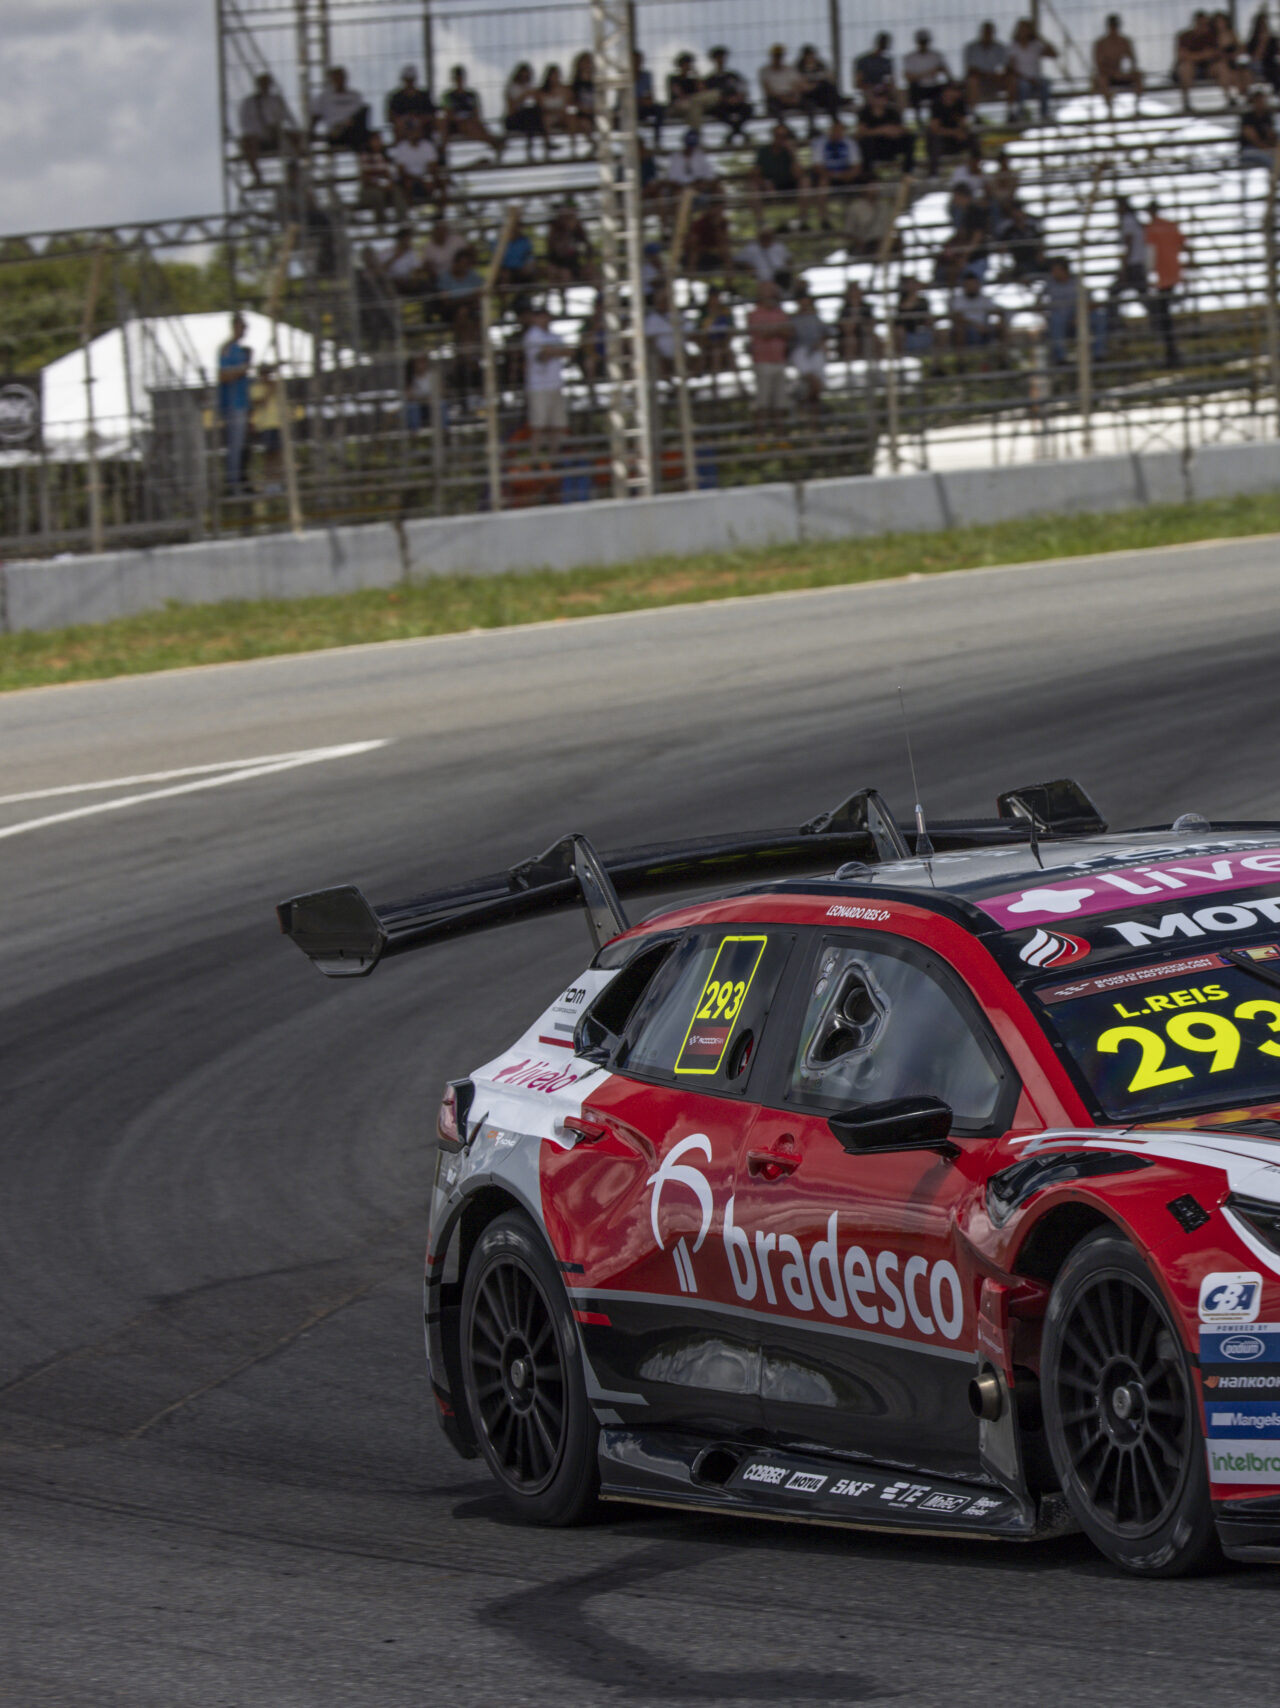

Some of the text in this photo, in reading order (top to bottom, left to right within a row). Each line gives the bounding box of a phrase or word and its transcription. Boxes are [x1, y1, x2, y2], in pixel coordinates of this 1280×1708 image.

[826, 905, 865, 919] LEONARDO
[862, 908, 881, 921] REIS
[1094, 974, 1126, 985] BAIXE
[1136, 963, 1185, 976] PADDOCK
[1107, 976, 1139, 986] VOTE
[1139, 971, 1158, 980] NO
[1158, 961, 1213, 976] FANPUSH
[696, 980, 746, 1020] 293
[1113, 984, 1230, 1019] L.REIS
[504, 1061, 578, 1094] livelo
[722, 1195, 963, 1340] bradesco
[1204, 1284, 1257, 1311] CBA
[1216, 1324, 1255, 1332] POWERED
[789, 1473, 824, 1492] MOTUL
[829, 1479, 877, 1497] SKF
